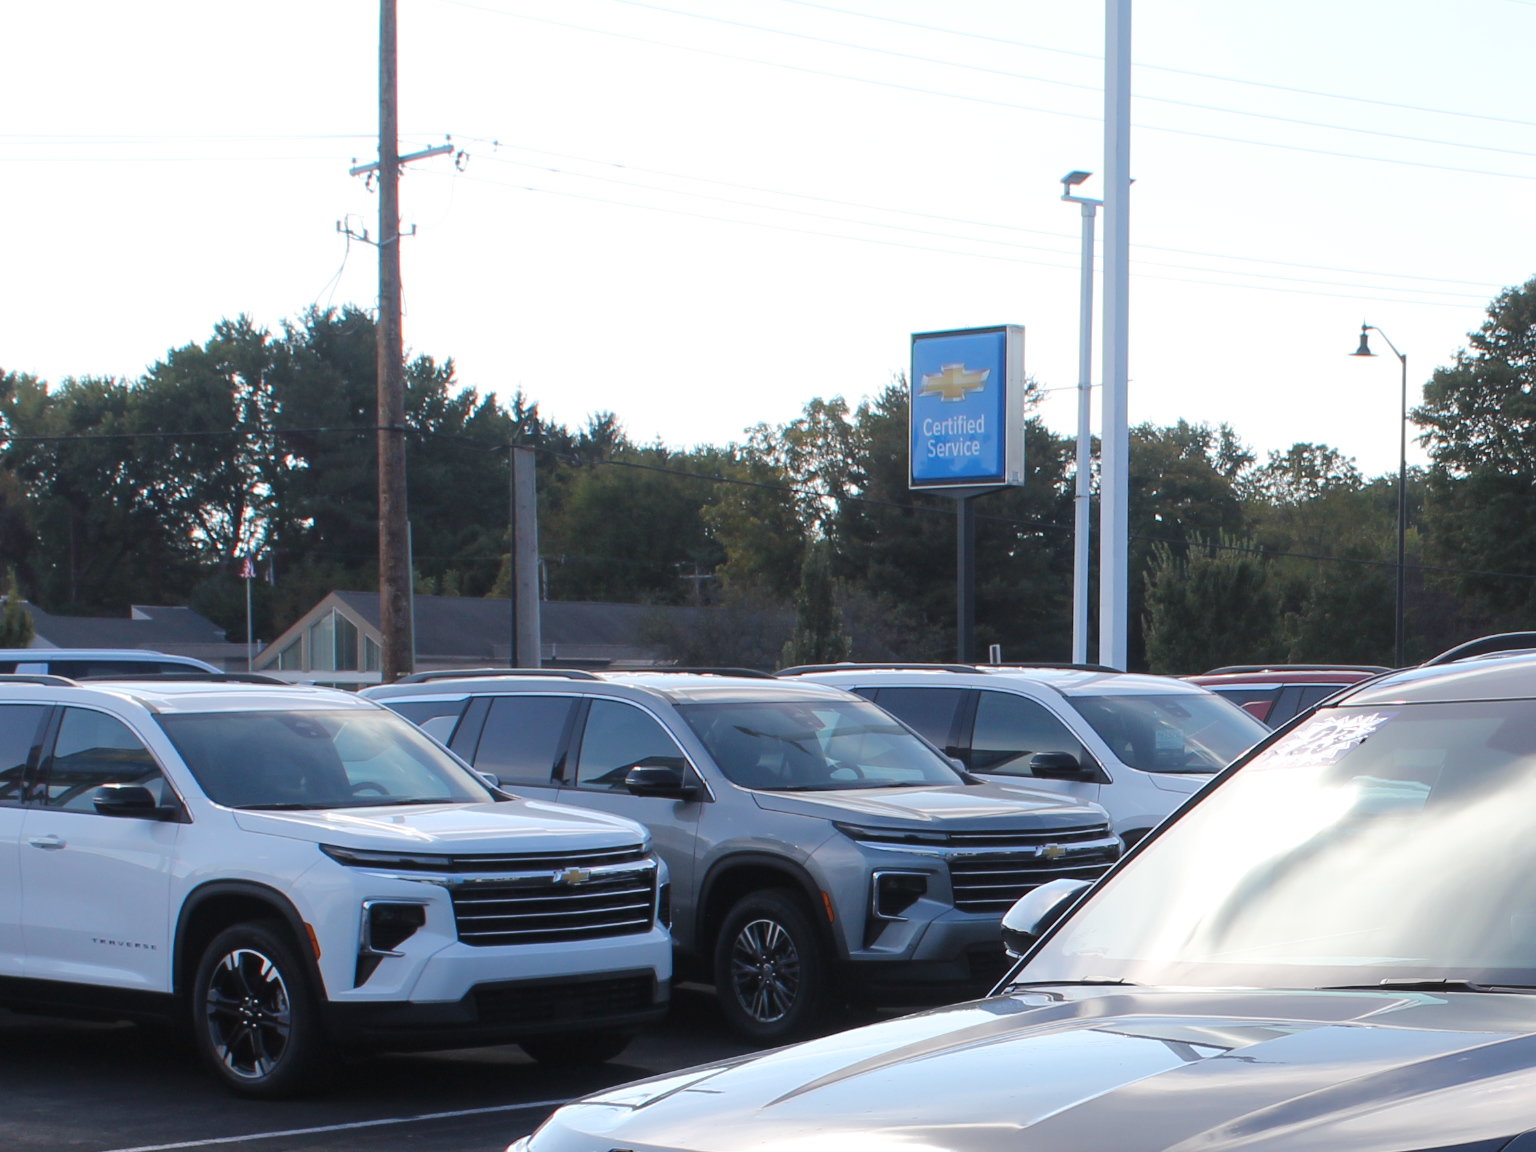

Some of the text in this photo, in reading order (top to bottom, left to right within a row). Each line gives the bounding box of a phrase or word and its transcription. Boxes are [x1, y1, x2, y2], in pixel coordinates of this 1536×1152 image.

[923, 414, 985, 437] Certified
[927, 437, 980, 458] Service
[92, 937, 158, 950] TRAVERSE
